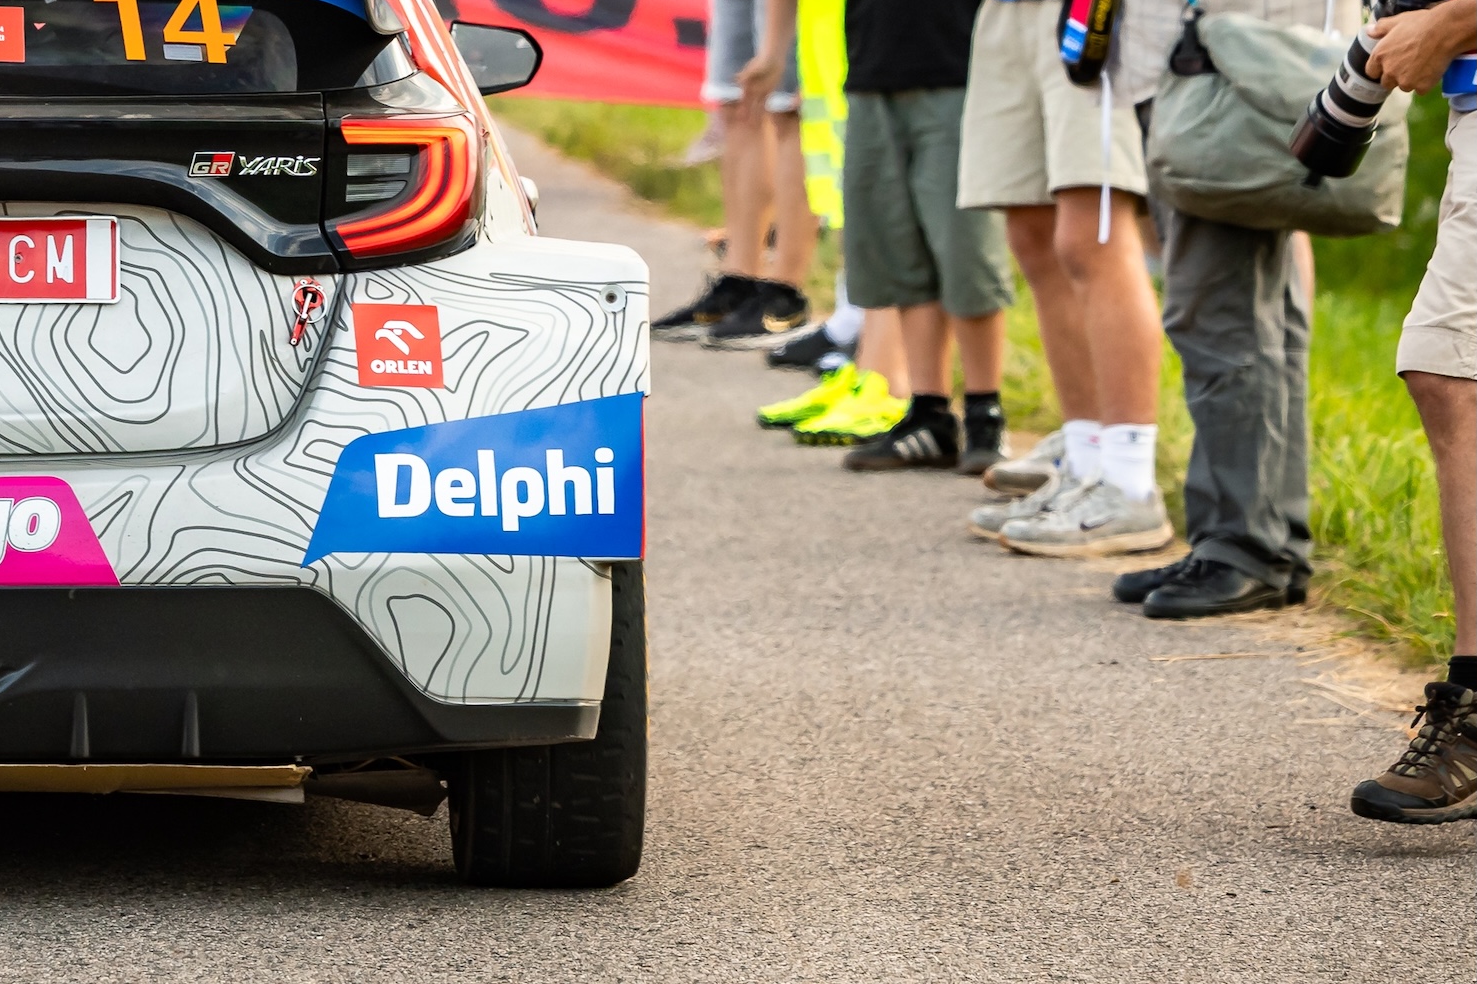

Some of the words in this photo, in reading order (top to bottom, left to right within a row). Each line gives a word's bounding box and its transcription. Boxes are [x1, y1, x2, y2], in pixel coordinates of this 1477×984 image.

[193, 161, 230, 174] GR
[370, 359, 433, 375] ORLEN
[374, 447, 615, 531] Delphi
